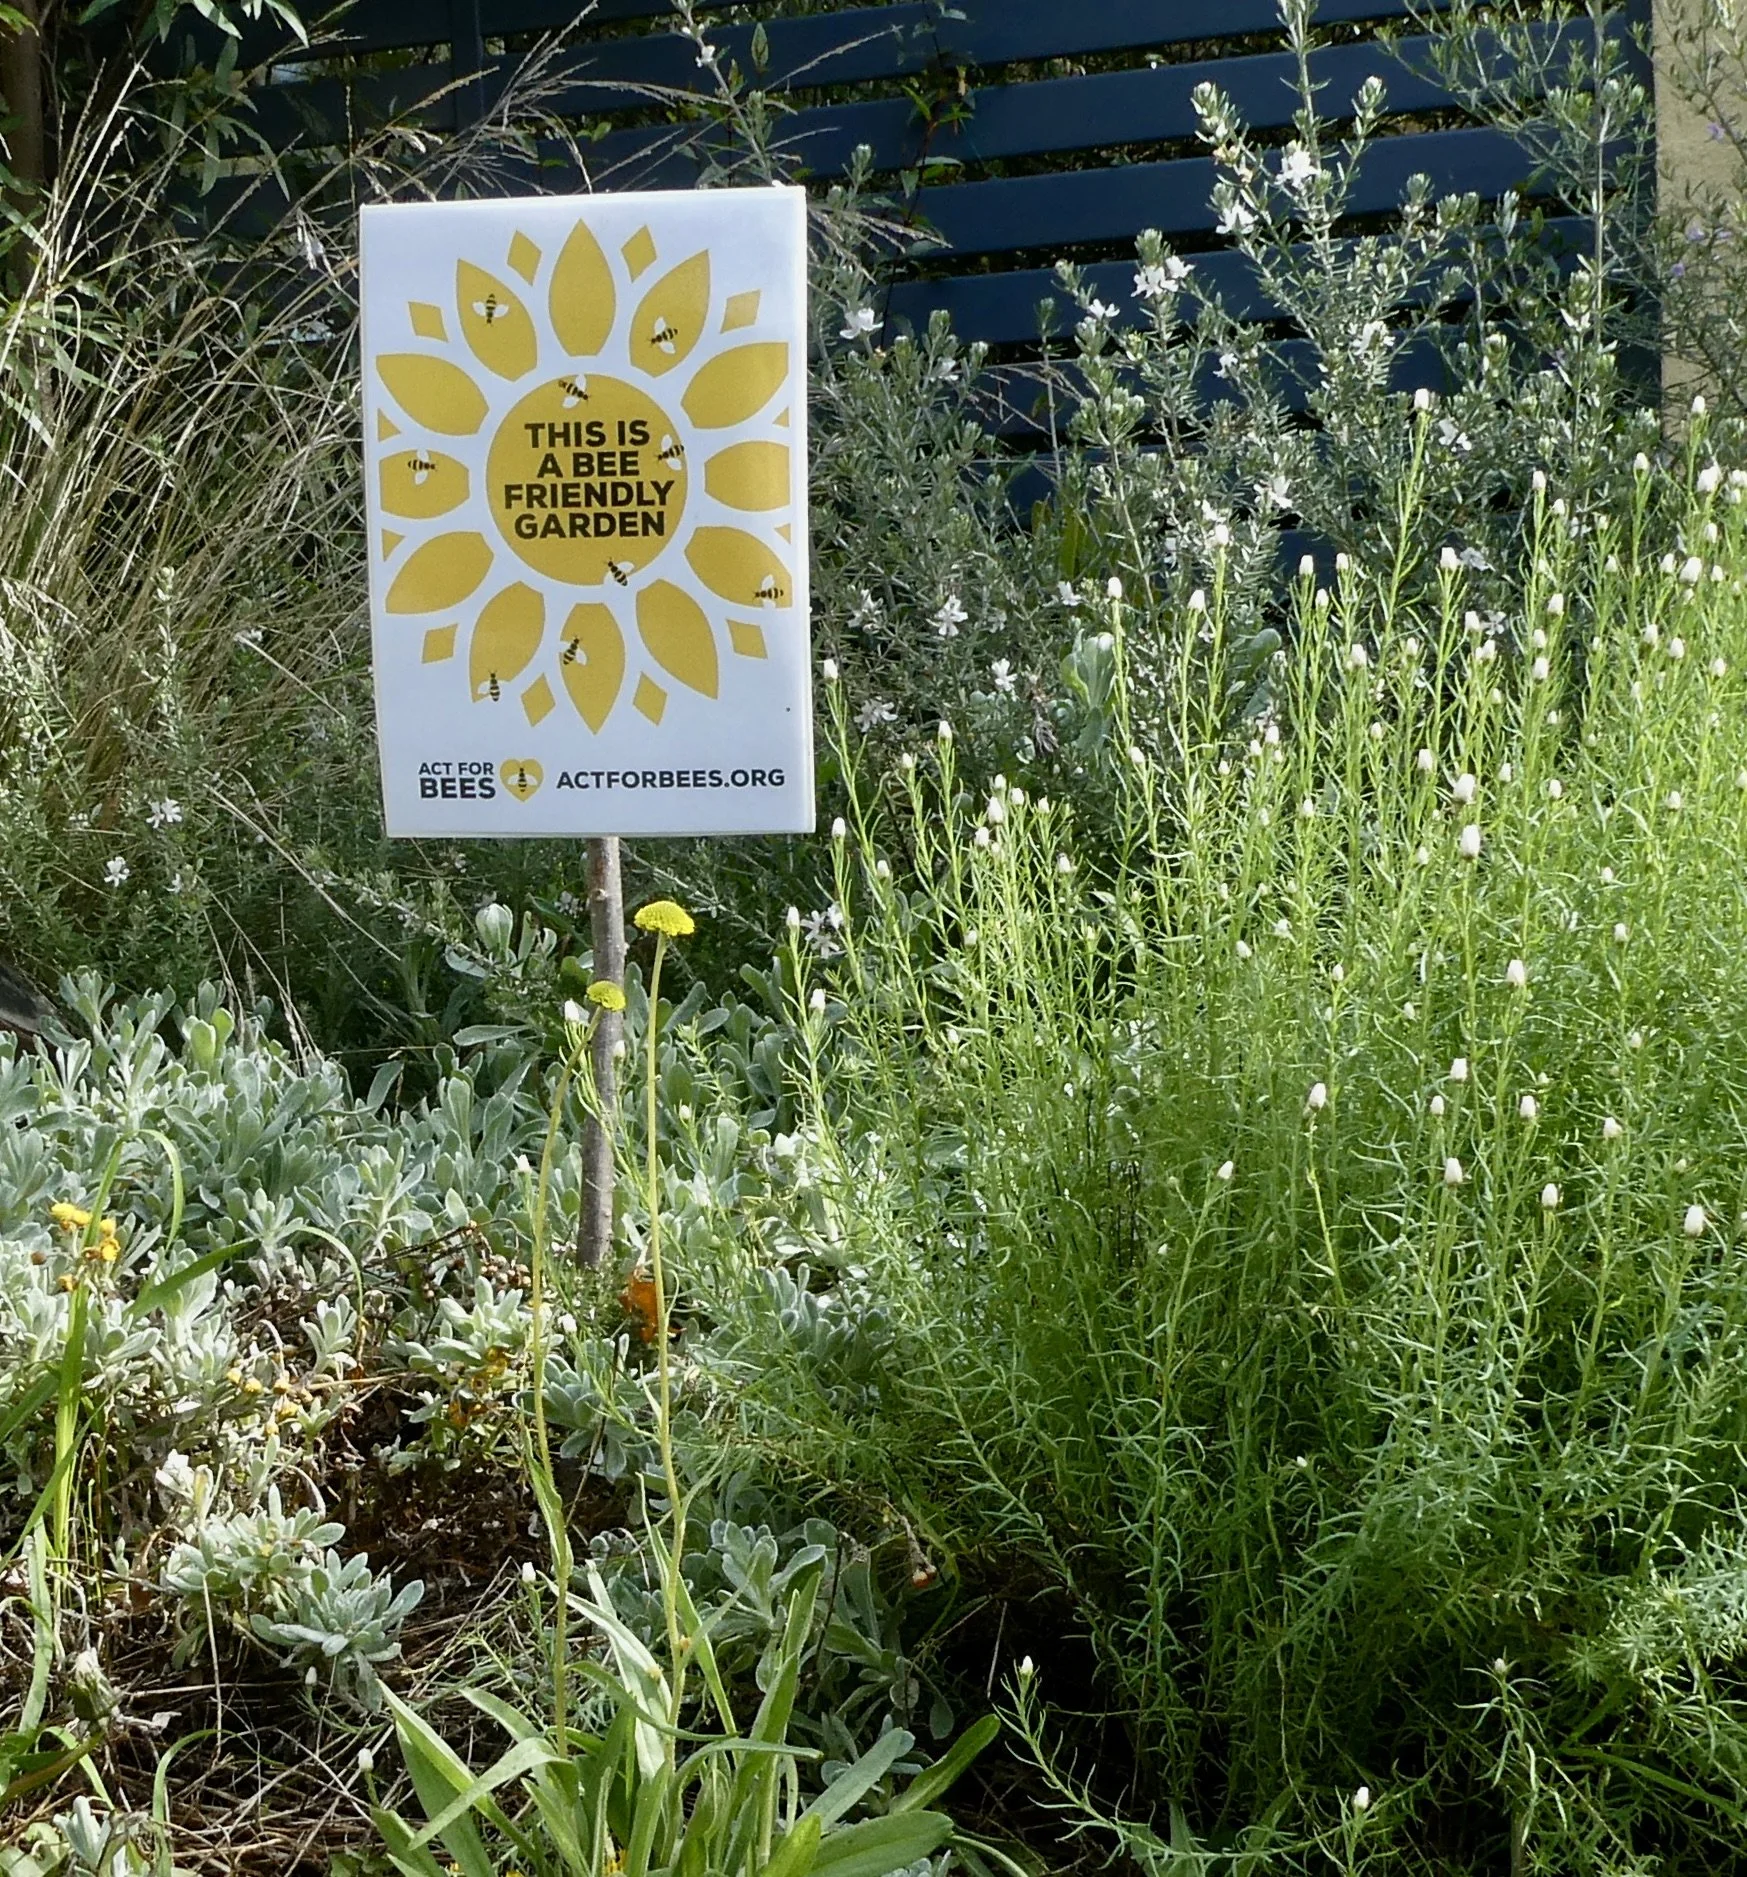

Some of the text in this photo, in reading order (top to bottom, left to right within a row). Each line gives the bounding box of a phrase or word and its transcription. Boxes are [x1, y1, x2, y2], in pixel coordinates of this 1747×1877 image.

[524, 420, 650, 448] THIS IS
[537, 451, 640, 478] A BEE
[504, 480, 675, 509] FRIENDLY
[515, 511, 665, 539] GARDEN
[419, 762, 494, 775] ACT FOR
[557, 769, 785, 789] ACTFORBEES.ORG
[420, 777, 496, 799] BEES
